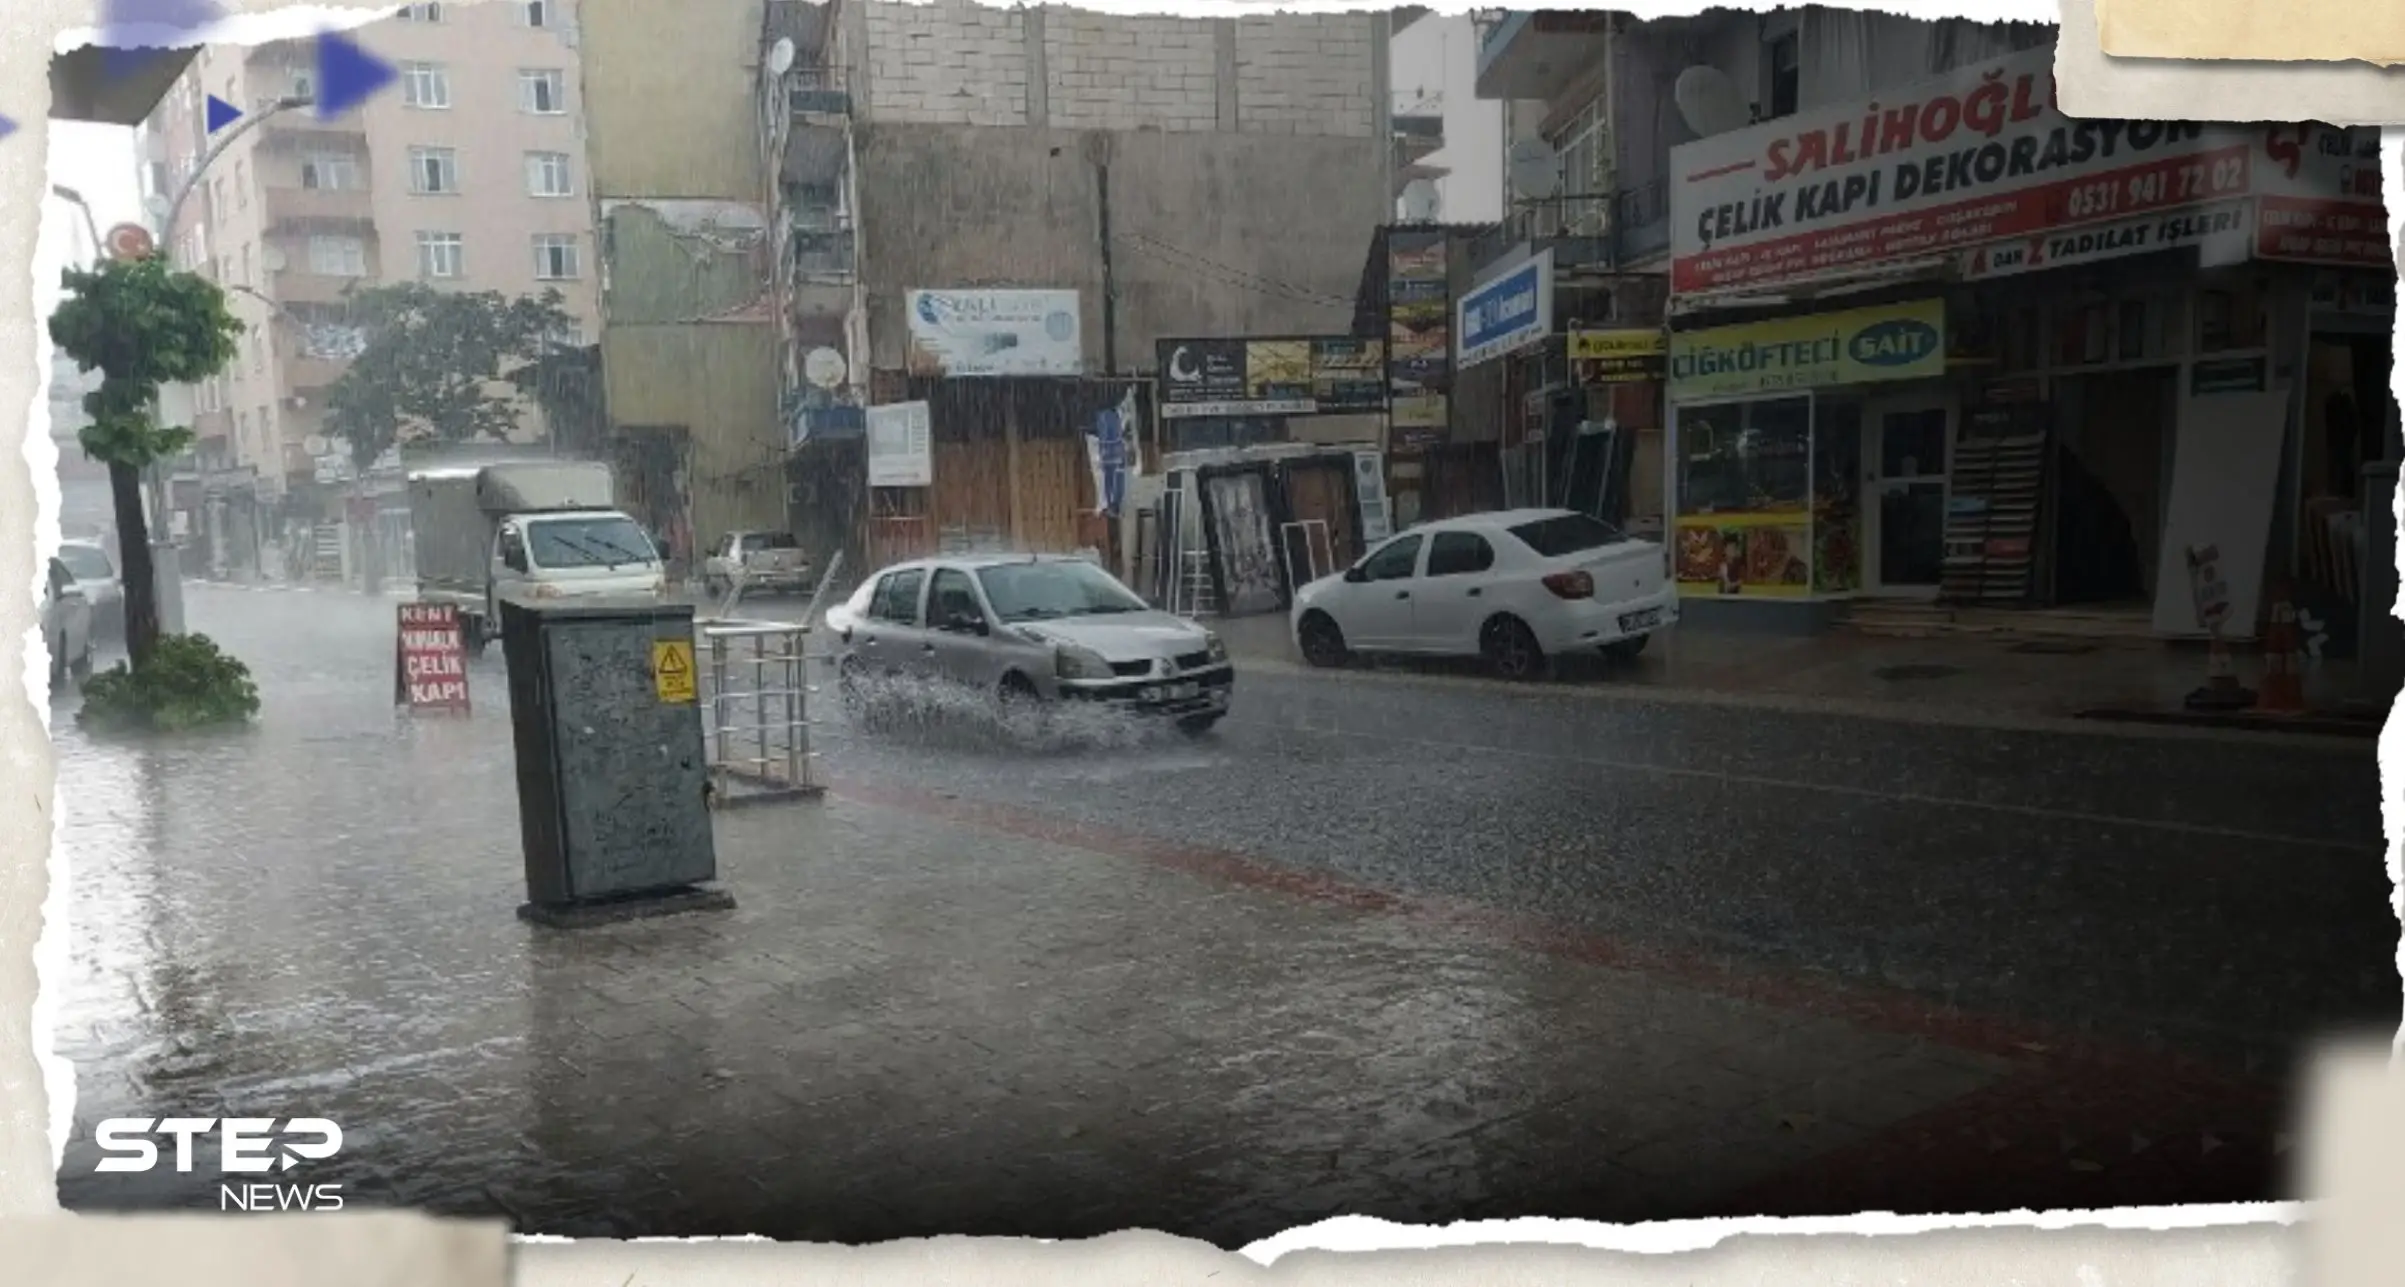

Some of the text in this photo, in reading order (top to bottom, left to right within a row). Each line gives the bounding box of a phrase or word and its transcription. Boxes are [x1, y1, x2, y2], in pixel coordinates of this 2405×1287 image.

[1764, 68, 2056, 182] SALİHOĞL
[1698, 188, 1786, 250] ÇELİK
[1795, 170, 1881, 222] KAPI
[2068, 156, 2243, 218] 0531 941 72 02
[1860, 326, 1924, 359] SAİT
[408, 651, 463, 681] ÇELİK
[410, 681, 466, 702] KAPI
